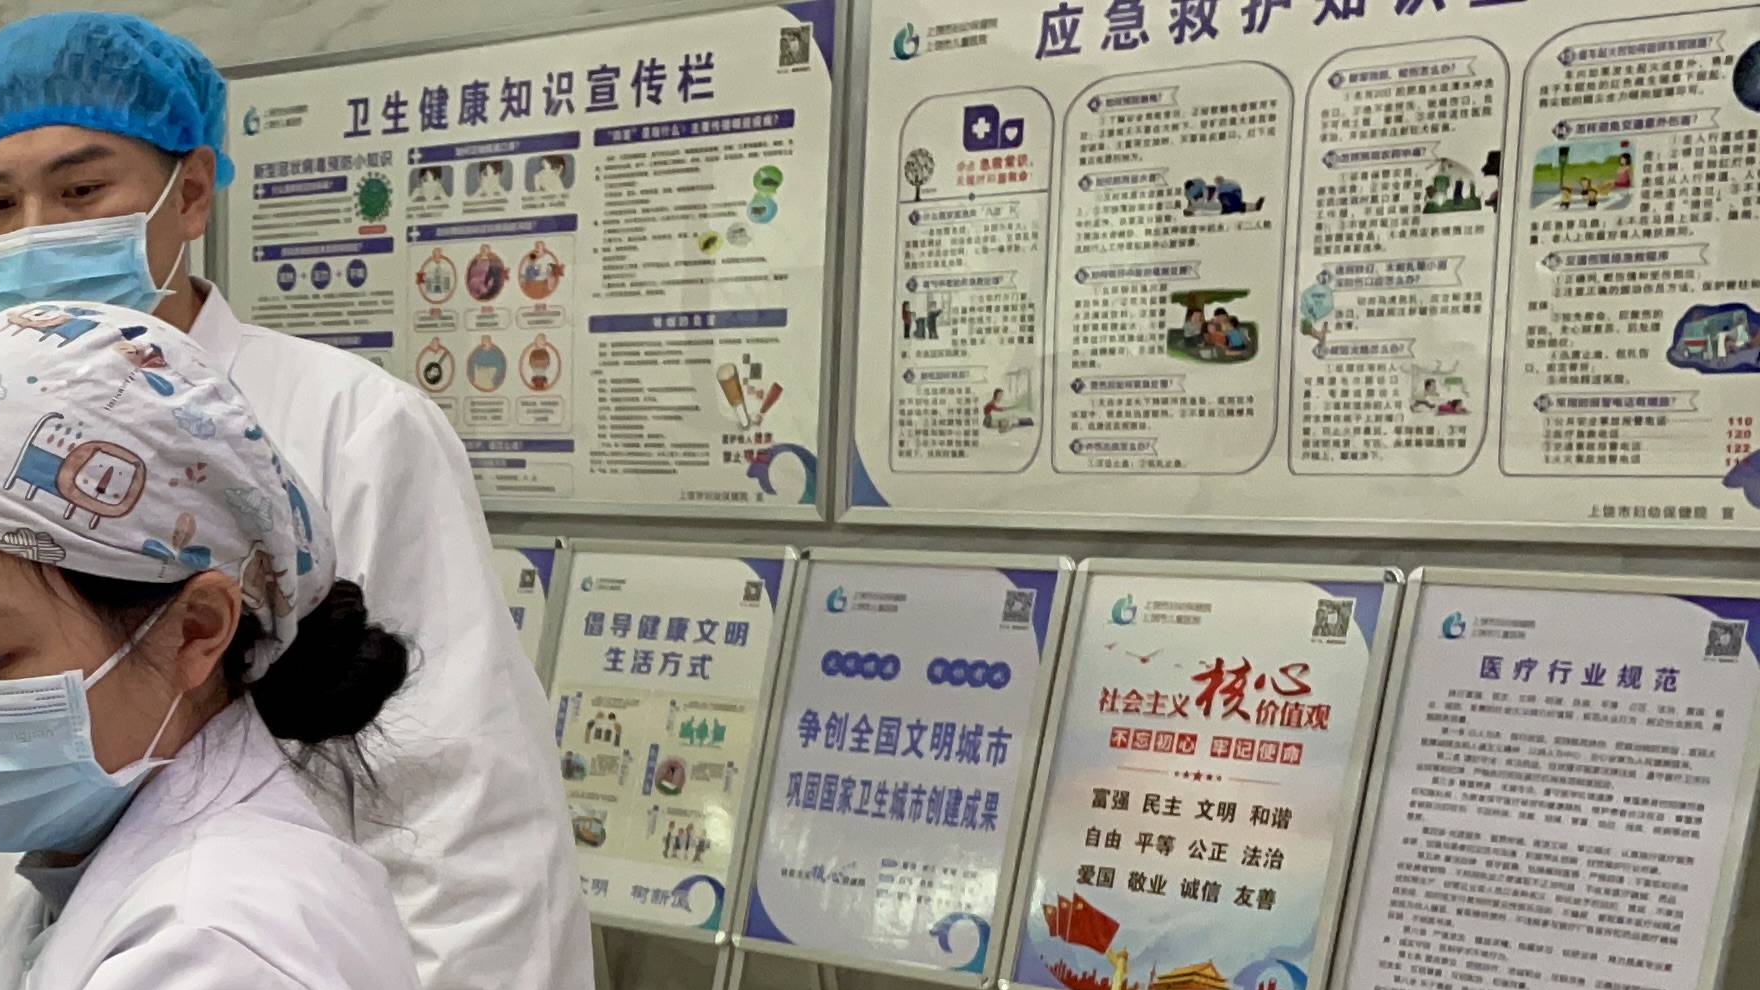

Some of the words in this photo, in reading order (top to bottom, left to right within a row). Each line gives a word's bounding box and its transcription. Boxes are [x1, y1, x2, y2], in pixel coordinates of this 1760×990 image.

[1035, 0, 1528, 60] 应急救护
[342, 51, 716, 138] 卫生健康知识宣传栏
[1587, 505, 1708, 521] 上饶市妇幼保健院
[583, 610, 750, 647] 倡导健康文明
[603, 646, 713, 681] 生活方式
[1479, 654, 1681, 693] 医疗行业规范
[1098, 655, 1332, 732] 社会主义核心价值观
[798, 707, 1013, 768] 争创全国文明城市
[1110, 727, 1198, 755] 不忘初心
[1211, 737, 1302, 764] 牢记使命
[786, 770, 1001, 833] 巩固国家卫生城市创建成果
[1091, 787, 1130, 811] 富强
[1142, 793, 1182, 817] 民主
[1194, 798, 1237, 824] 文明
[1249, 804, 1293, 830] 和谐
[1084, 825, 1122, 850] 自由
[1134, 831, 1177, 857] 平等
[1188, 838, 1229, 863] 公正
[1241, 844, 1285, 871] 法治
[1077, 864, 1116, 889] 爱国
[1127, 870, 1168, 896] 敬业
[1180, 877, 1223, 904] 诚信
[1233, 884, 1277, 911] 友善
